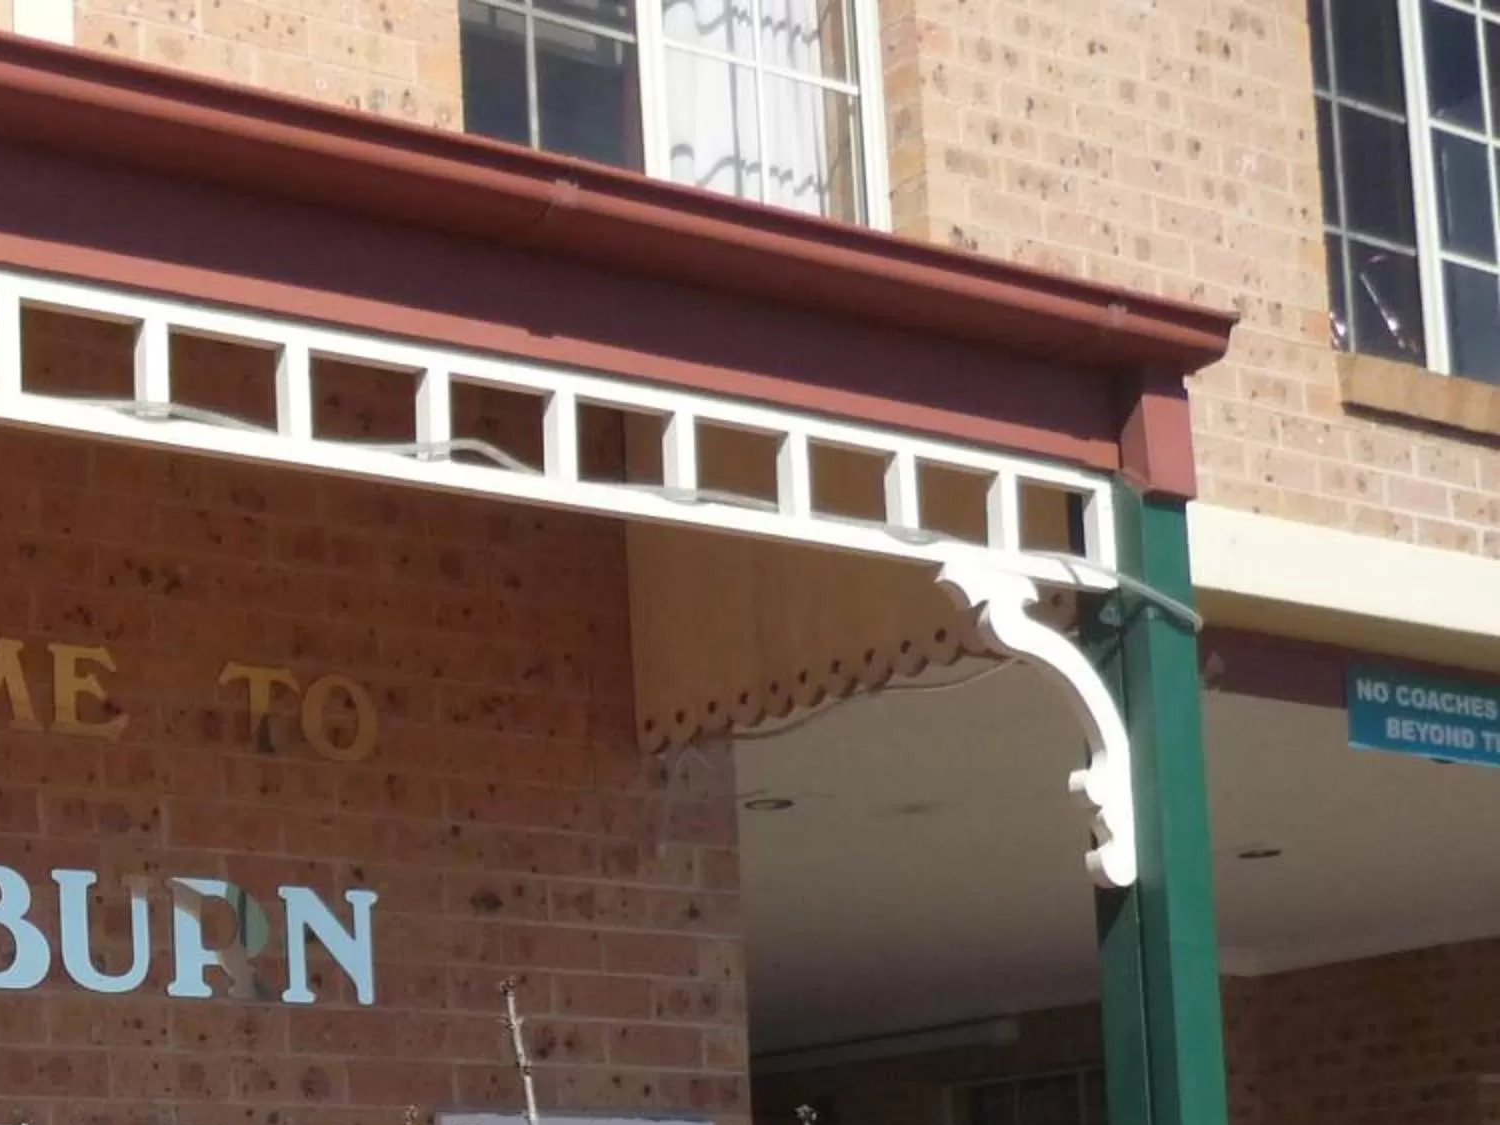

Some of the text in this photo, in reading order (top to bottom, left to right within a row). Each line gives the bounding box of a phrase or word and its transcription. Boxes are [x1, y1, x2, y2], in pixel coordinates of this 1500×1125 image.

[218, 661, 380, 763] TO
[1356, 678, 1498, 720] NO COACHES
[1385, 716, 1476, 749] BEYOND
